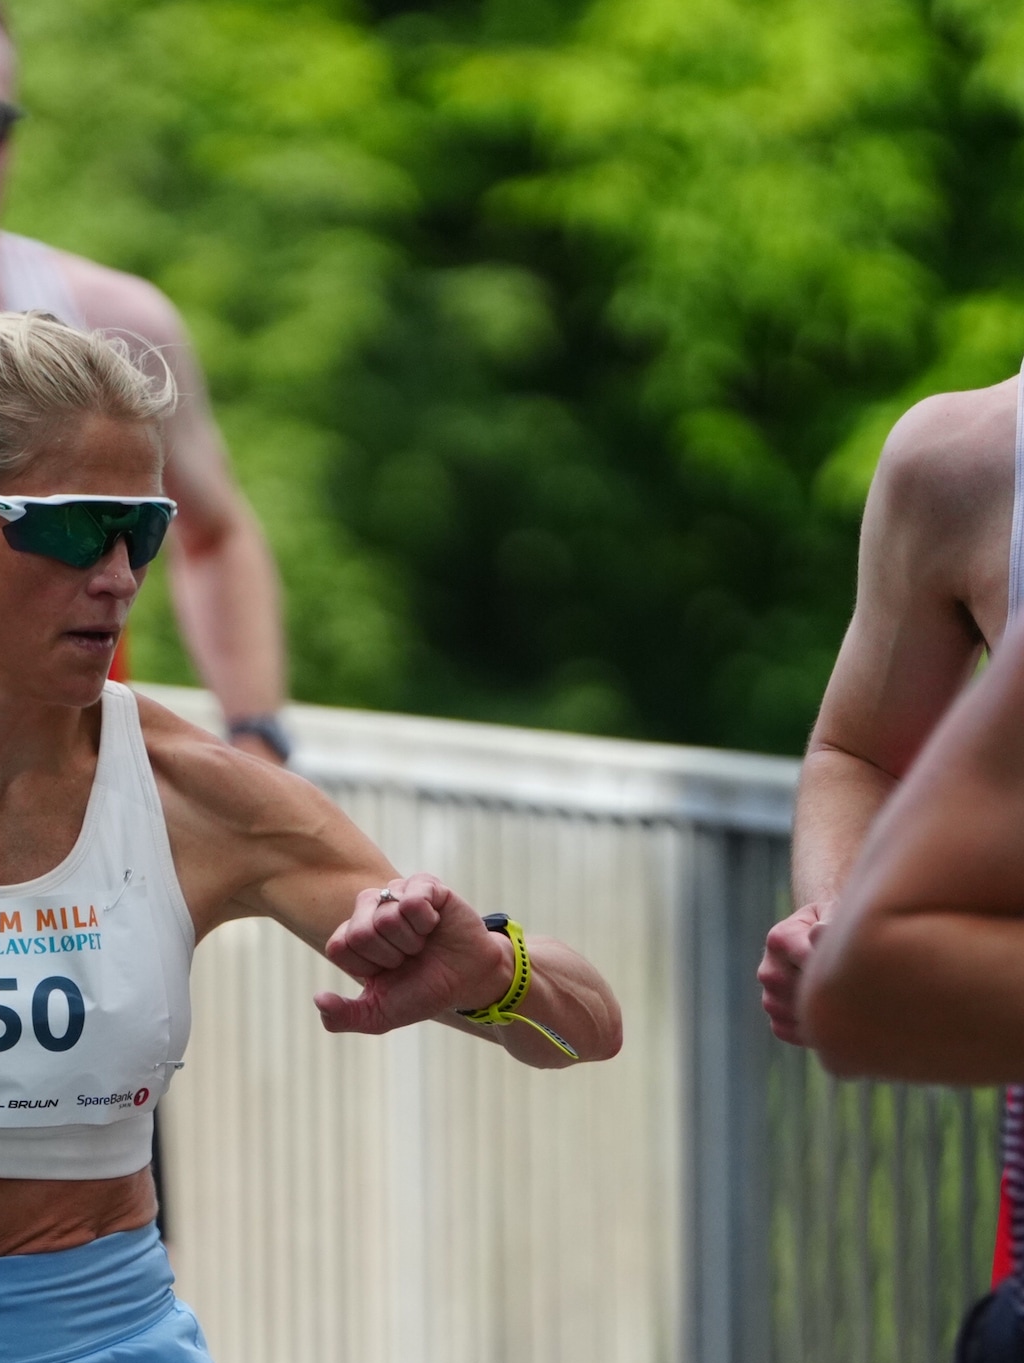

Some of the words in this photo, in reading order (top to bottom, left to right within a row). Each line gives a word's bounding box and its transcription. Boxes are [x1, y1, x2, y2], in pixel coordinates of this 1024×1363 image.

[36, 905, 98, 931] MILA
[8, 1099, 59, 1109] BRUUN
[77, 1091, 133, 1107] SpareBank
